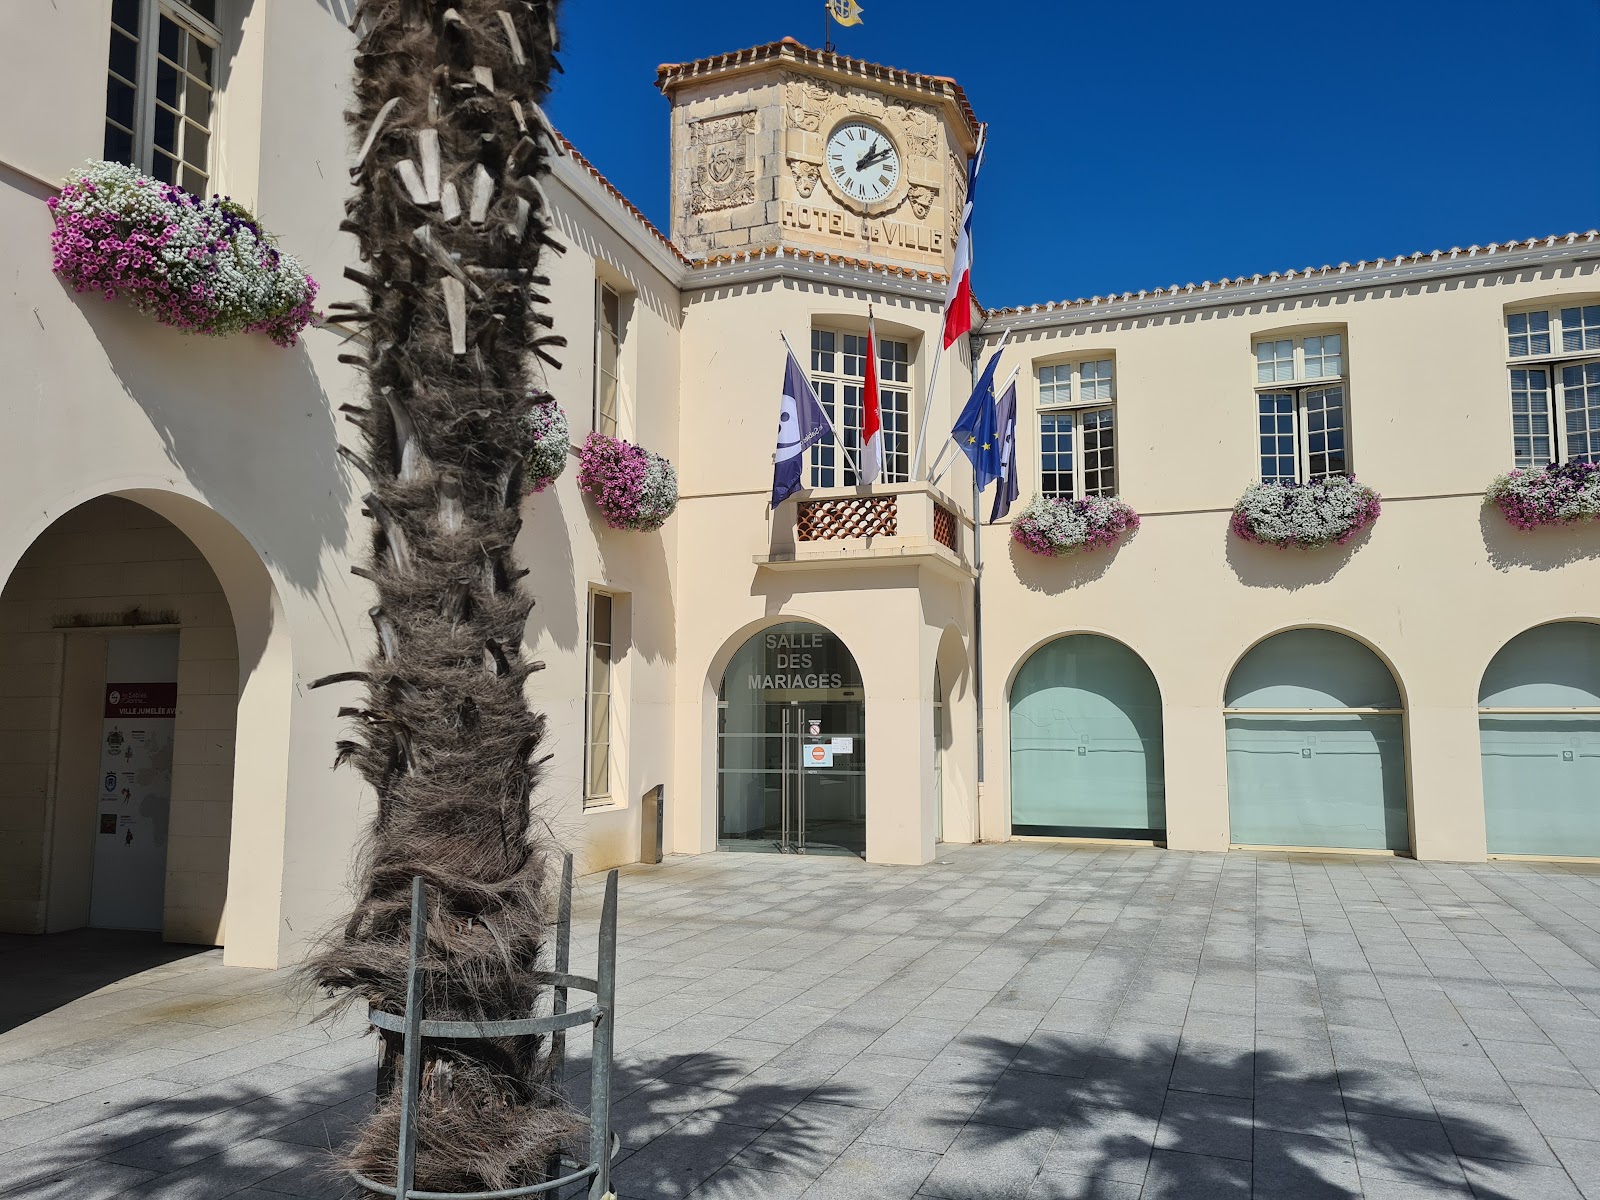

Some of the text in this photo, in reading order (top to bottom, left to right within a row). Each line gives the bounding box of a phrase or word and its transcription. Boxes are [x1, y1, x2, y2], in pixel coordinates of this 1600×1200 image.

[881, 219, 943, 254] VILLE
[766, 633, 823, 649] SALLE
[777, 653, 813, 669] DES
[748, 673, 842, 689] MARIAGES
[119, 707, 136, 715] VILLE
[137, 706, 166, 715] JUMELÉE
